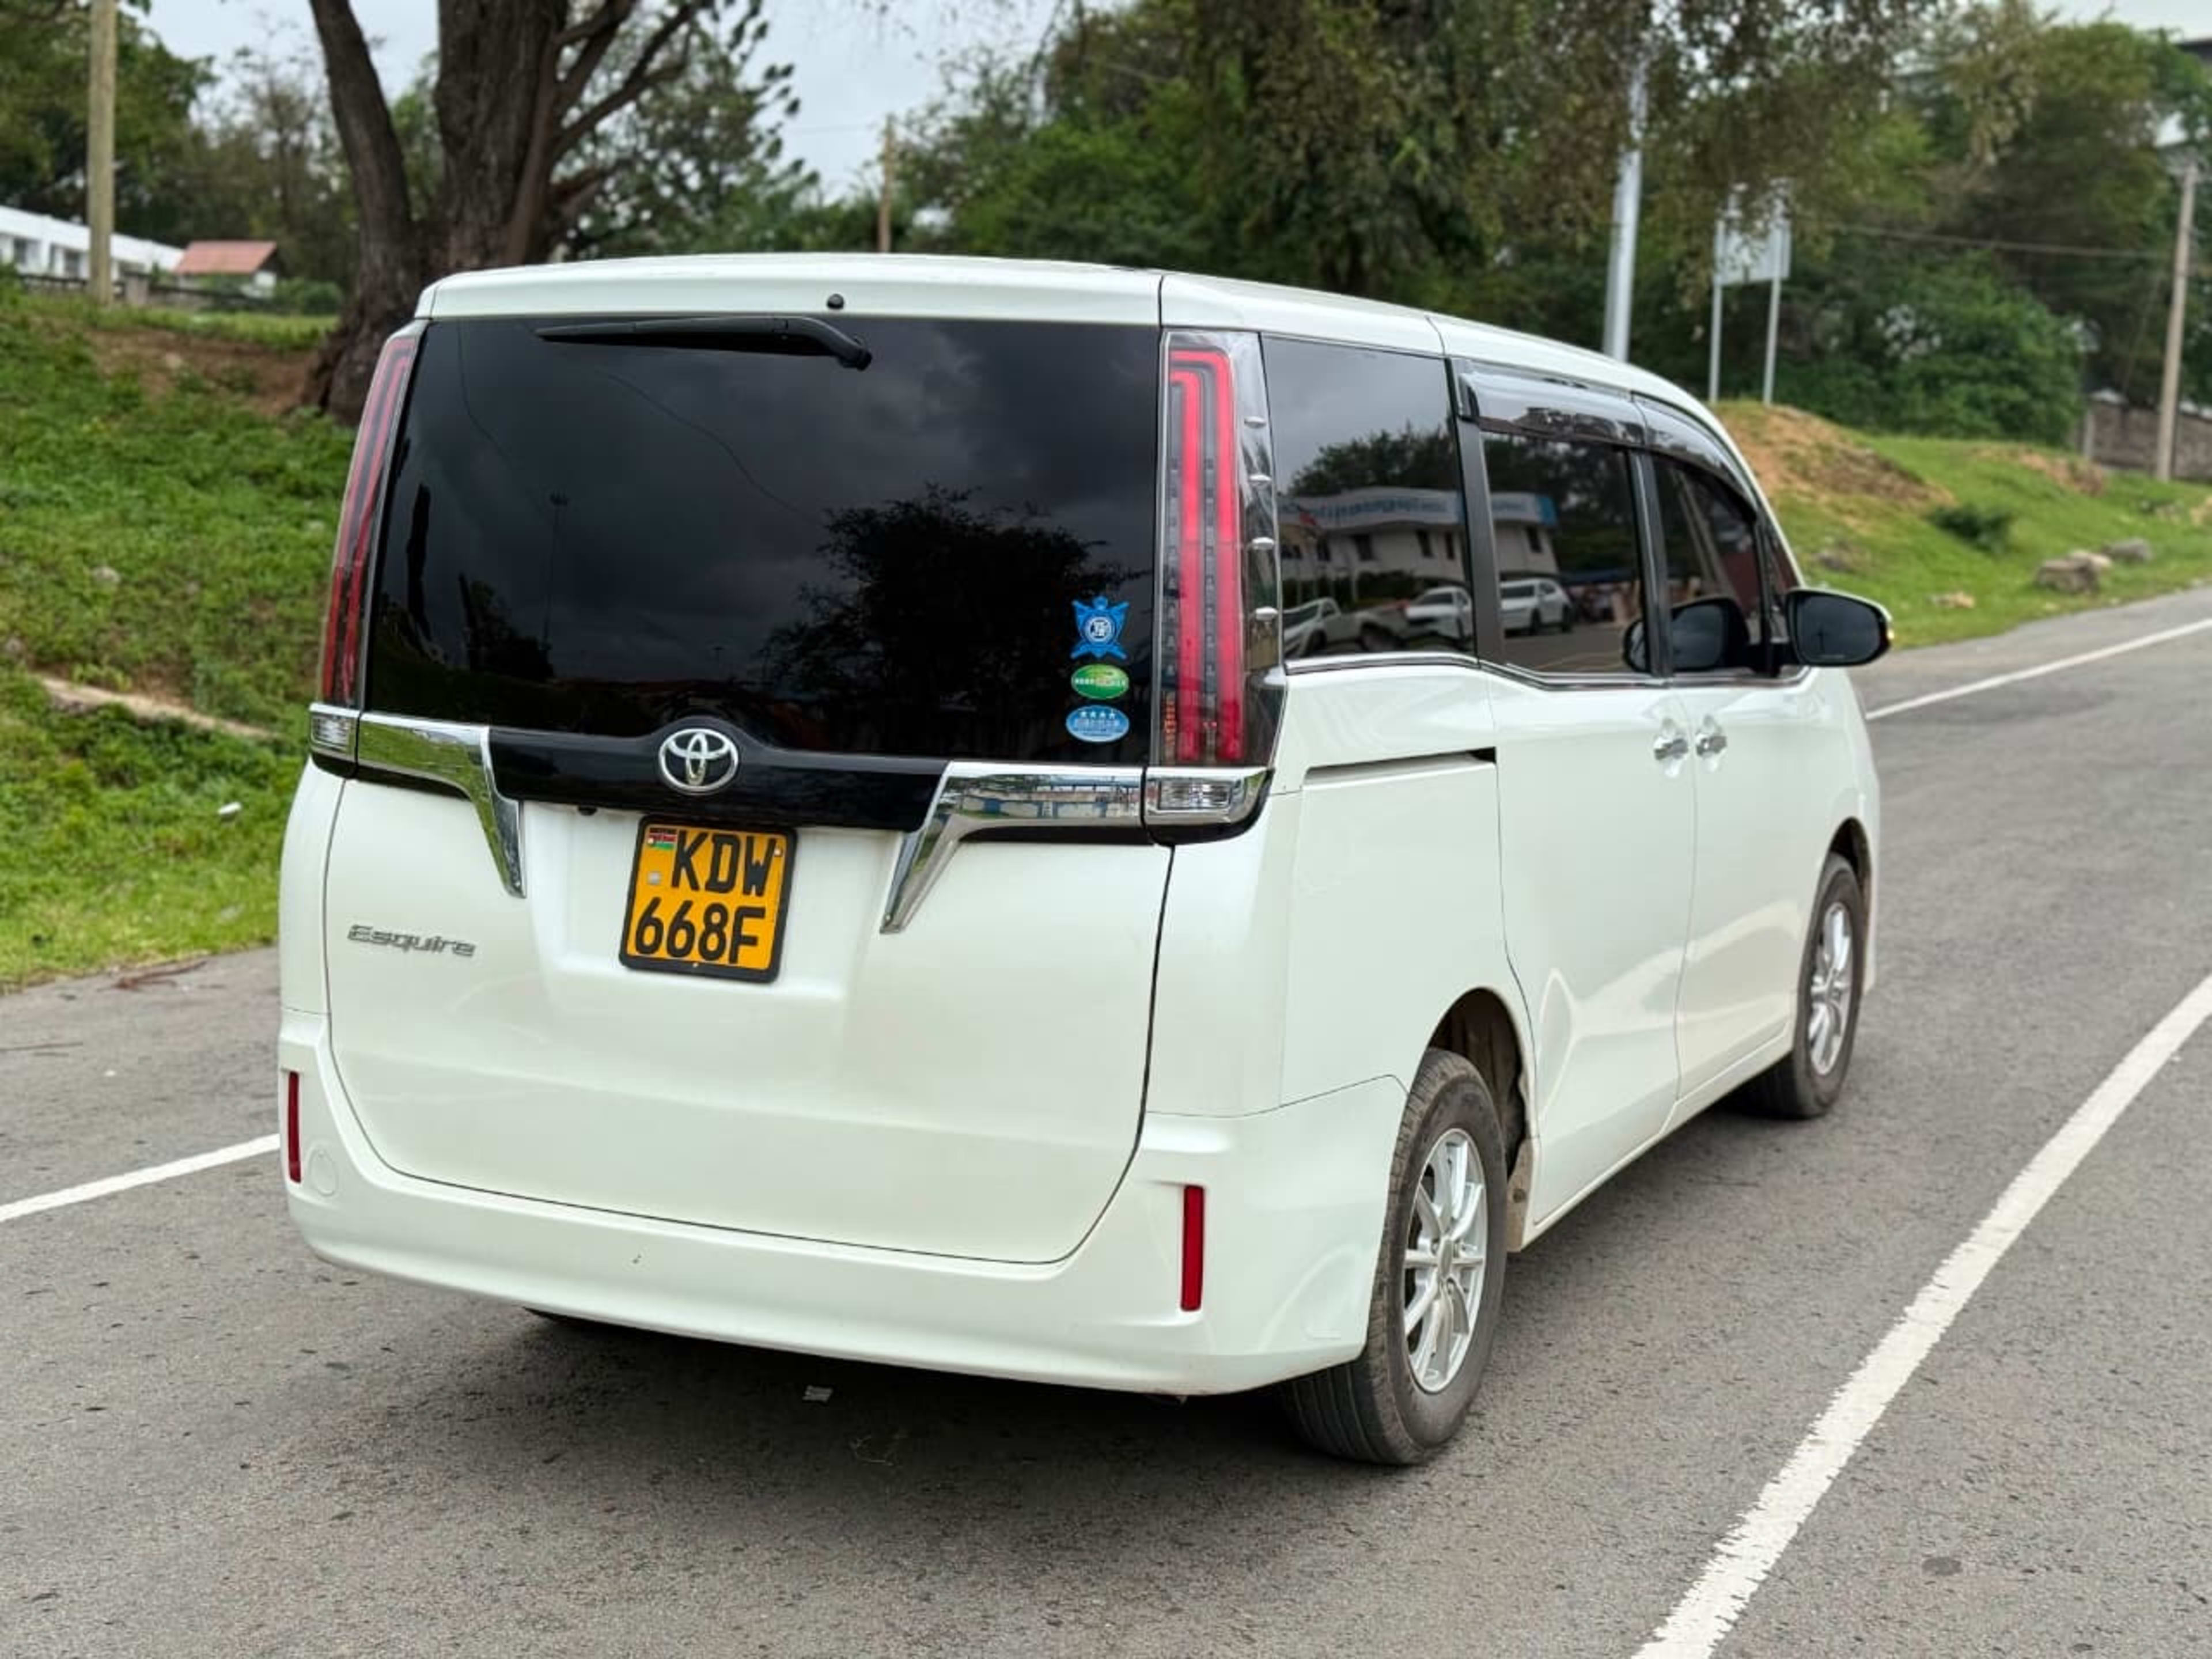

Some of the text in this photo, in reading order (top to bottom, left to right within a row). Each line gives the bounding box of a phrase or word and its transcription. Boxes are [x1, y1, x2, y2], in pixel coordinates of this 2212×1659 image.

[671, 830, 777, 896] KDW
[347, 924, 476, 957] Esquire
[635, 897, 766, 964] 668F
